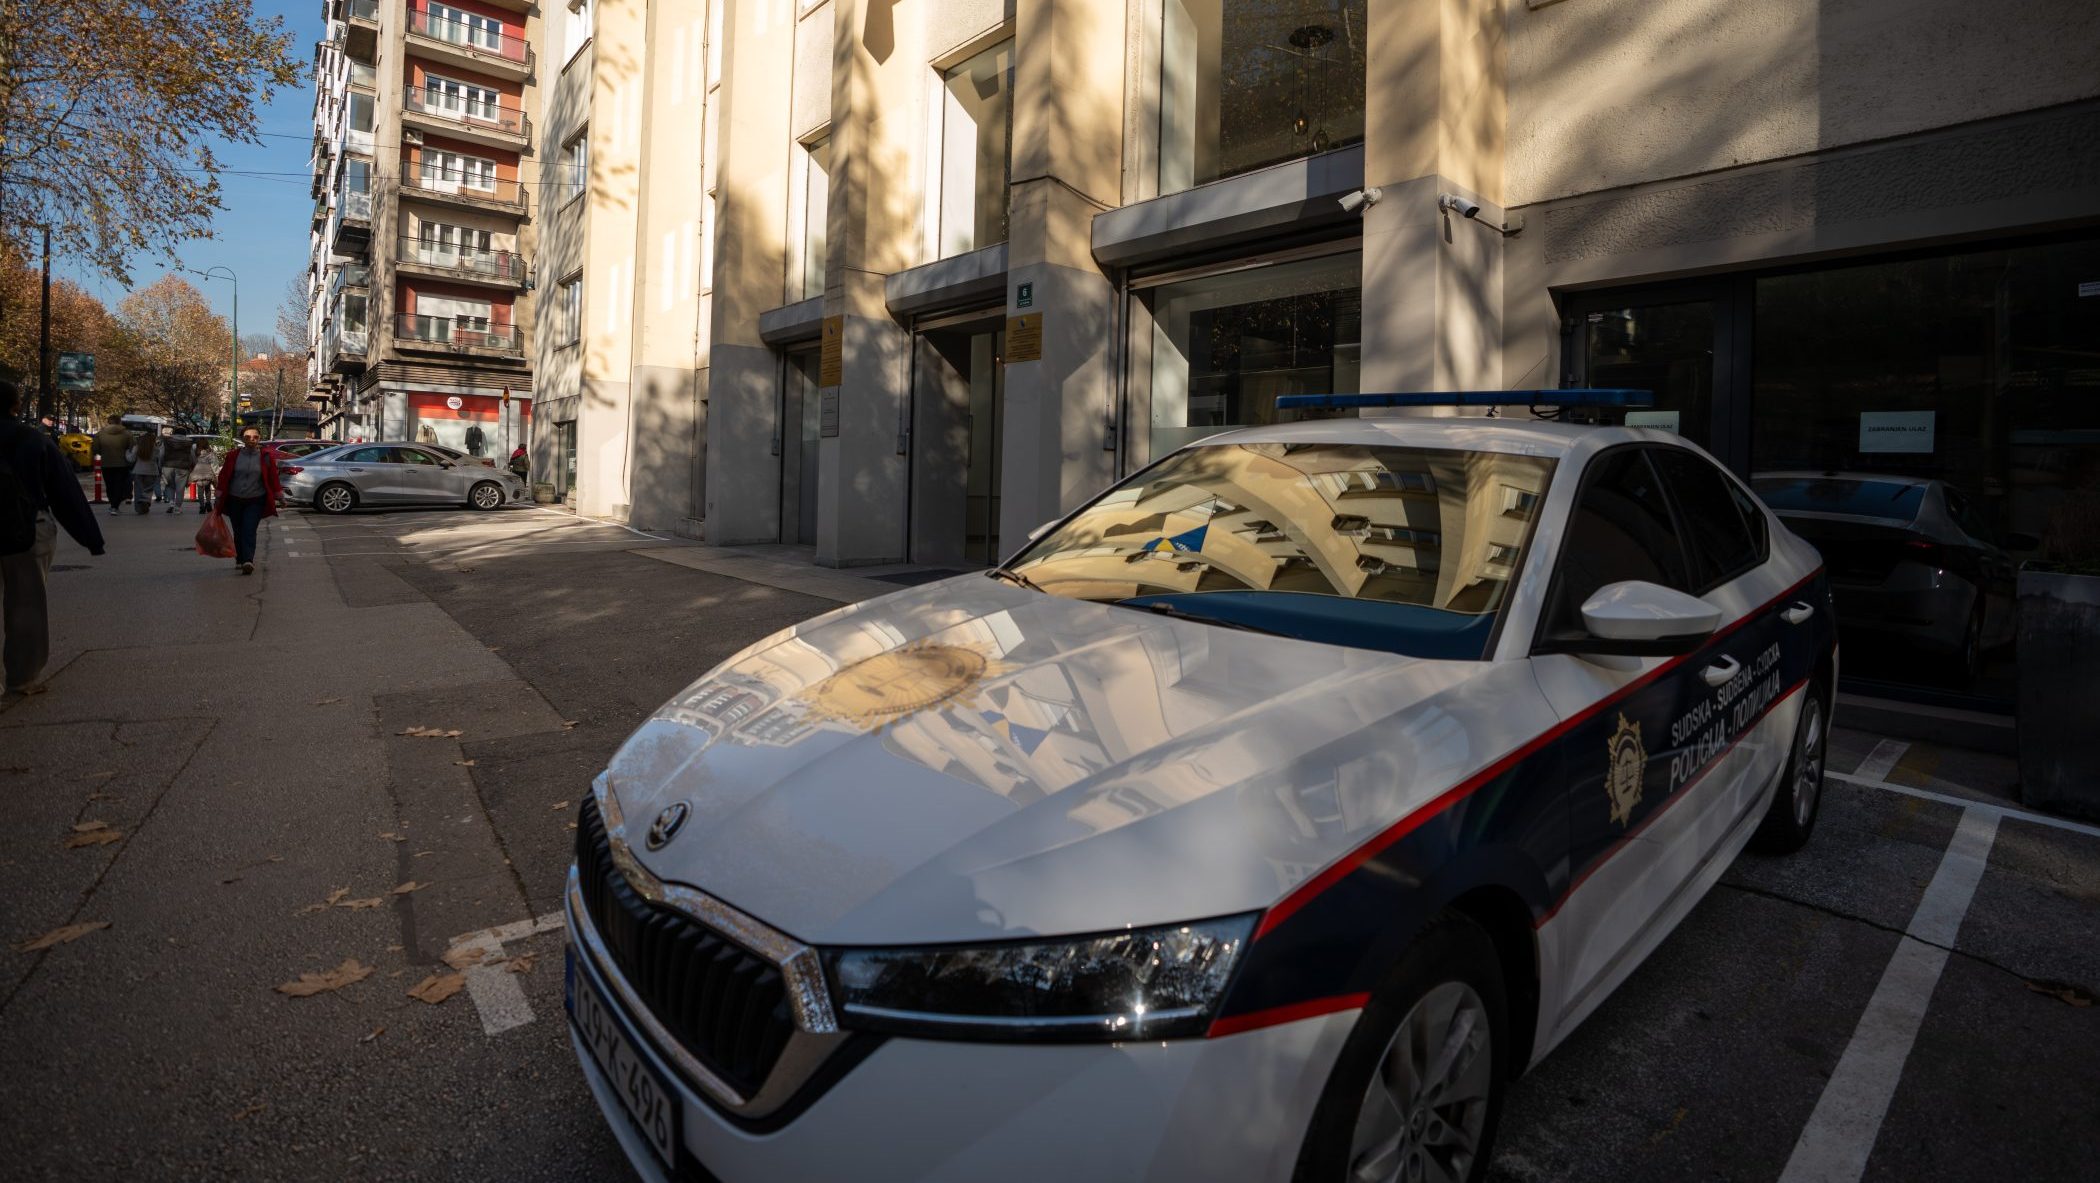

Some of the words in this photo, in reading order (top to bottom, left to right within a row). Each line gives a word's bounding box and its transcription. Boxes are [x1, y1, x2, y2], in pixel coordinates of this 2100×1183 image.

[1022, 288, 1029, 297] 6
[1671, 698, 1712, 748] SUDSKA
[1669, 718, 1726, 792] POLICIJA
